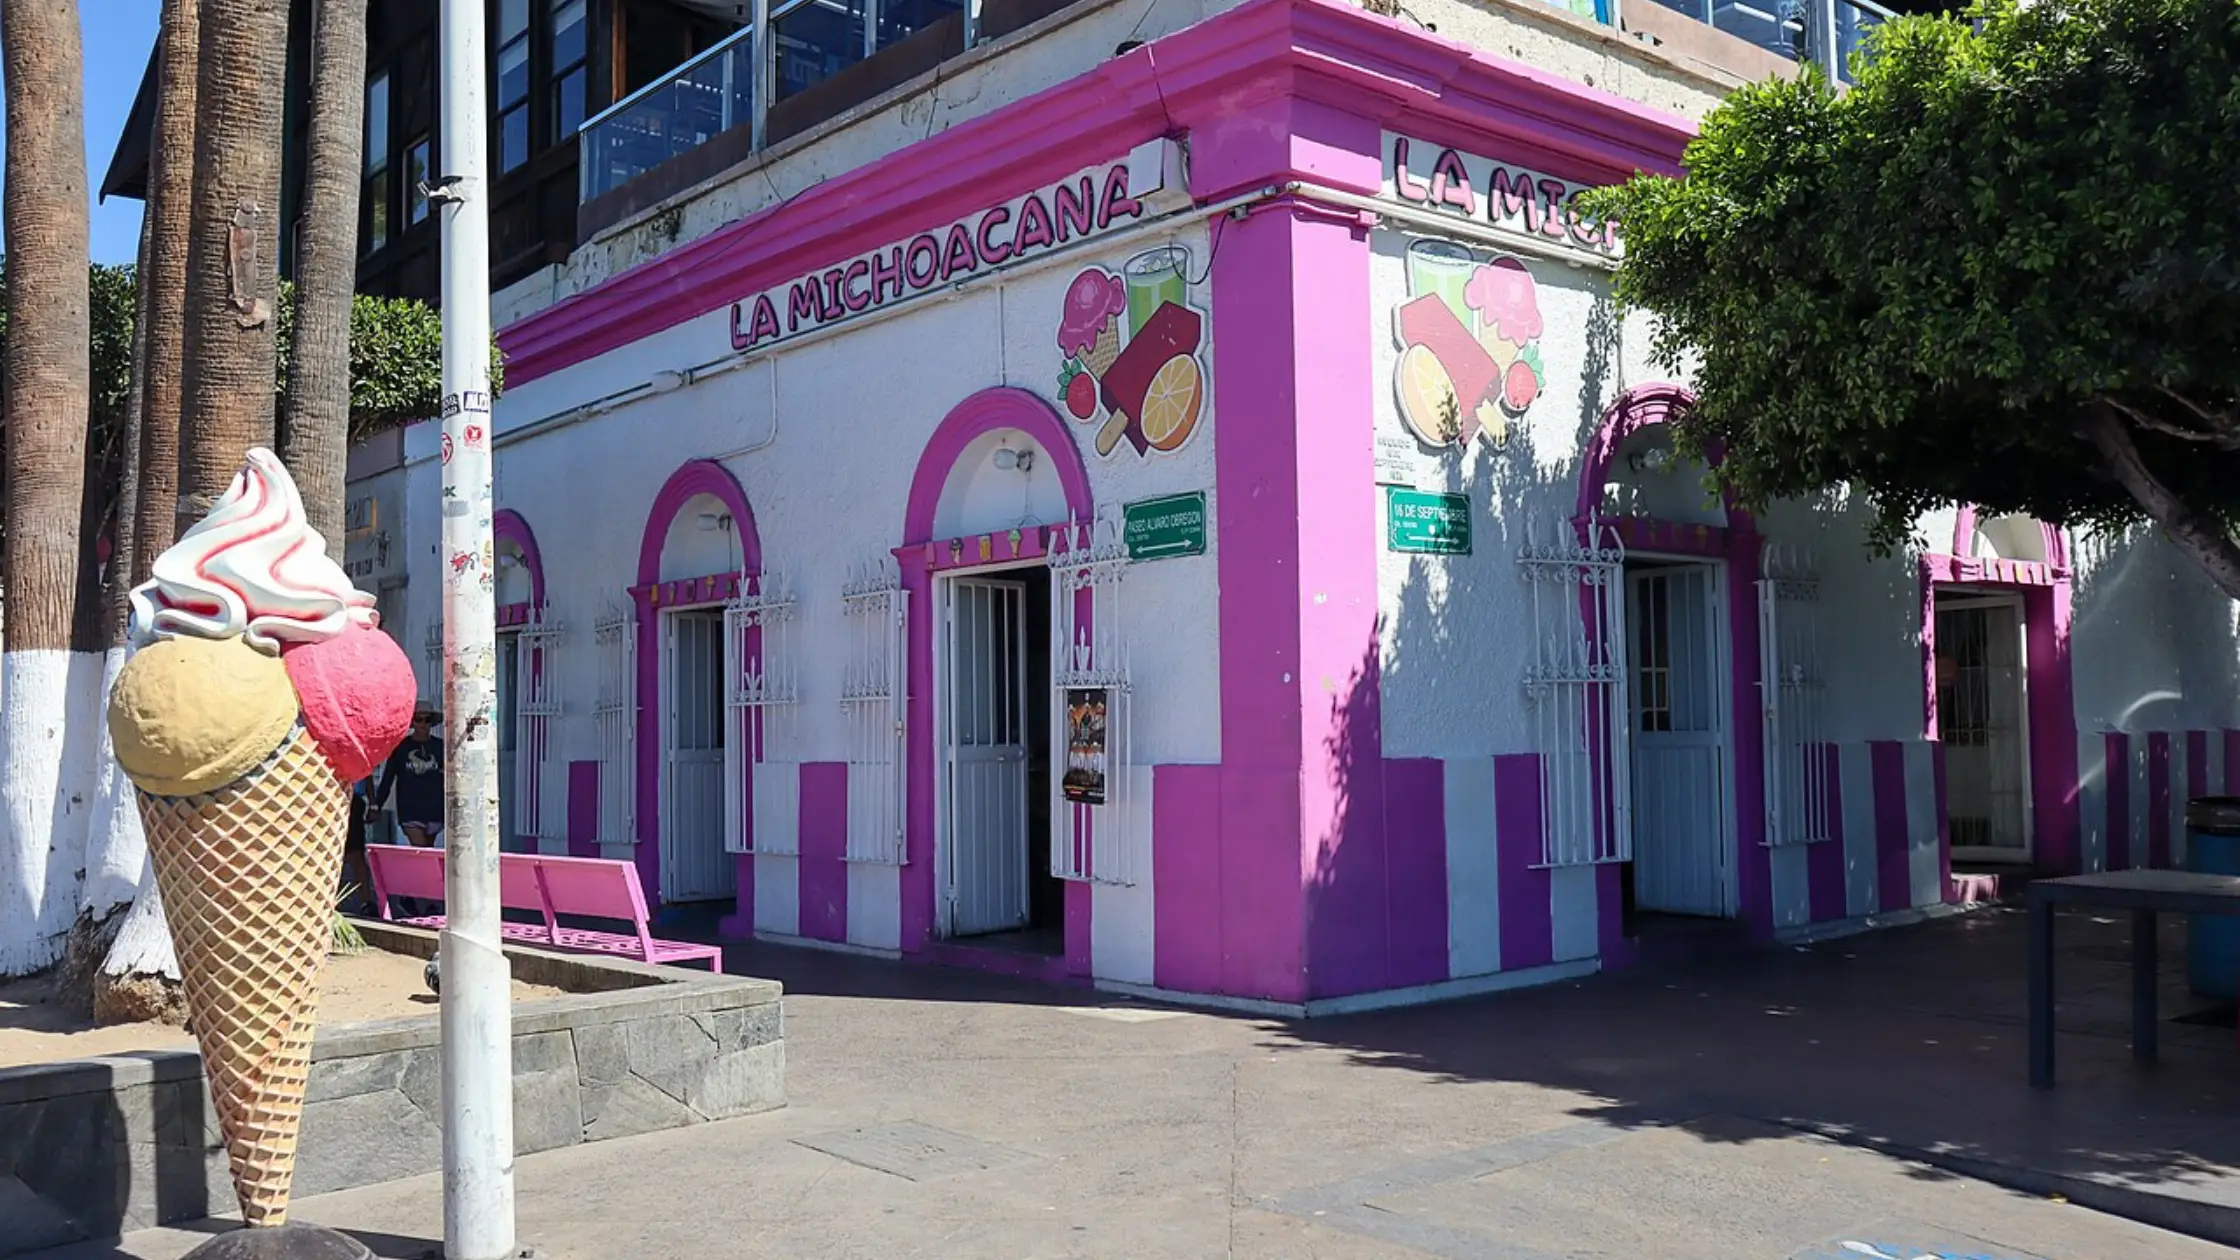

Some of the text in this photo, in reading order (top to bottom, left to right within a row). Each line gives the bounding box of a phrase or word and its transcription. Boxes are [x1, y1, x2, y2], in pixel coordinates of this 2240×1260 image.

[1394, 137, 1476, 214] LA
[730, 164, 1142, 350] LA MICHOACANA
[1405, 504, 1416, 518] DE
